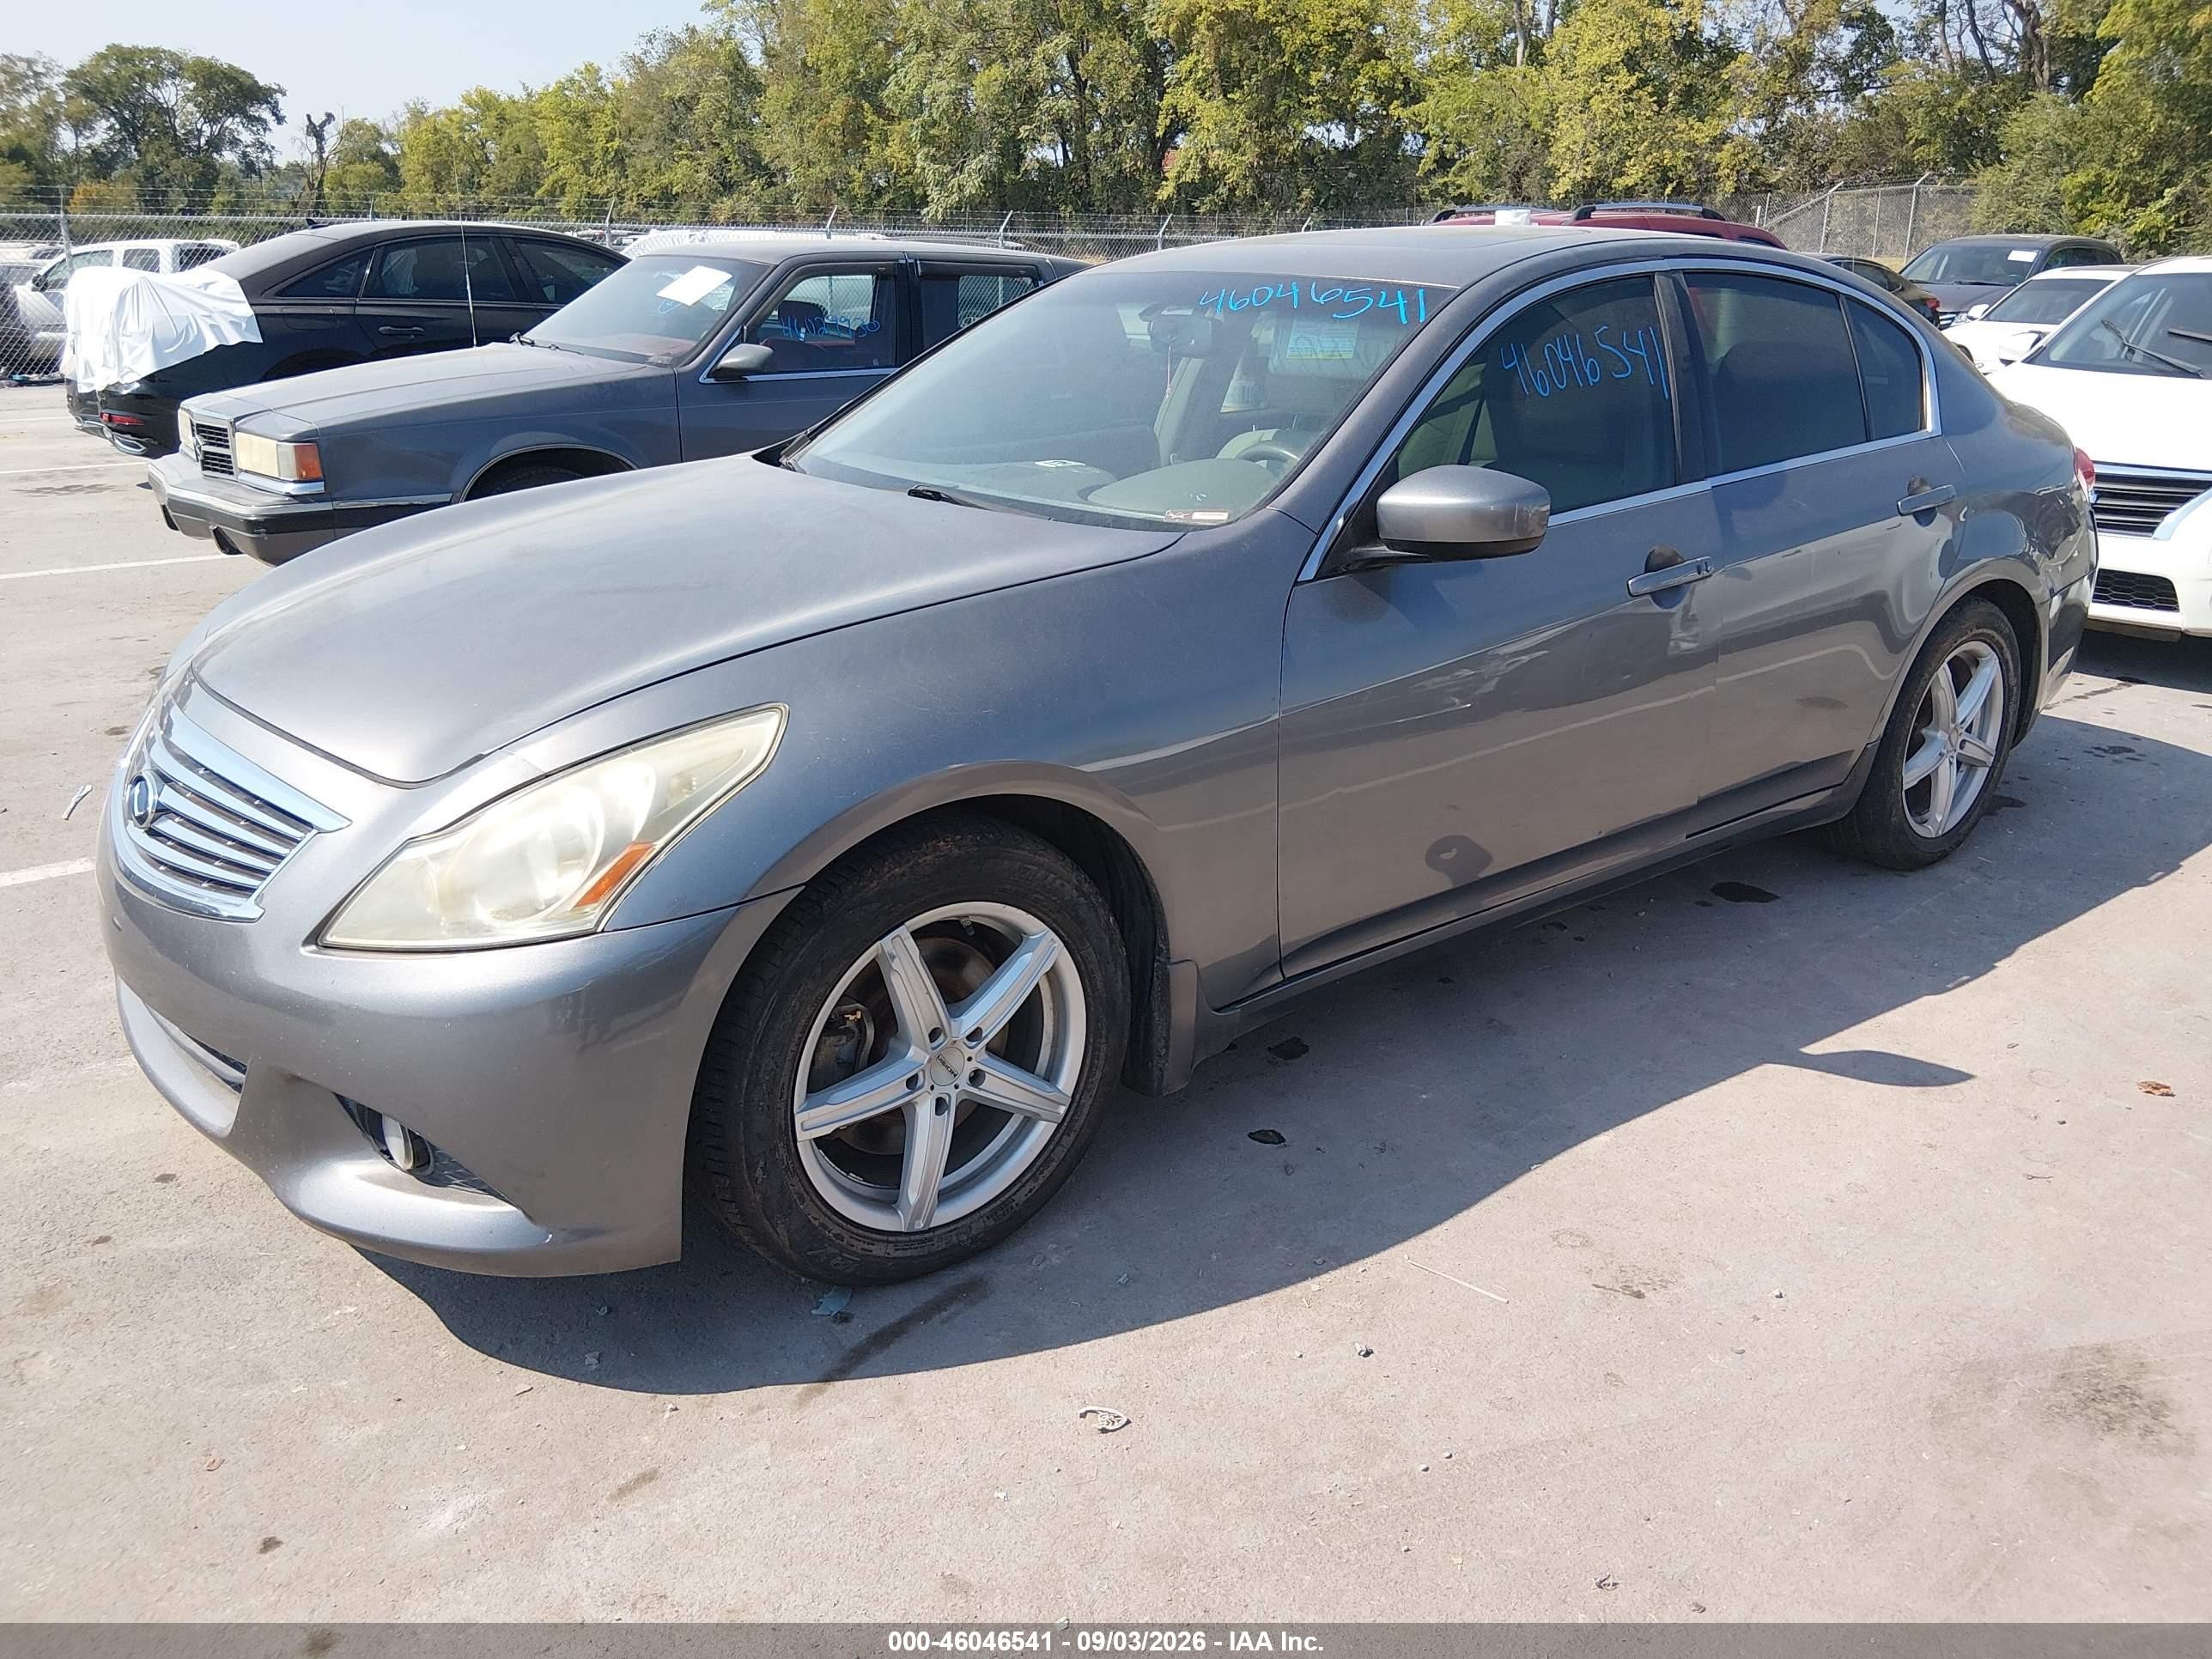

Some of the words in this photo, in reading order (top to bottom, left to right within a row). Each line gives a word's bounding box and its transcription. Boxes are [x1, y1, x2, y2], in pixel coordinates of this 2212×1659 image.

[1199, 282, 1426, 325] 46046541
[1500, 324, 1669, 399] 46046541
[936, 1053, 959, 1079] VISION
